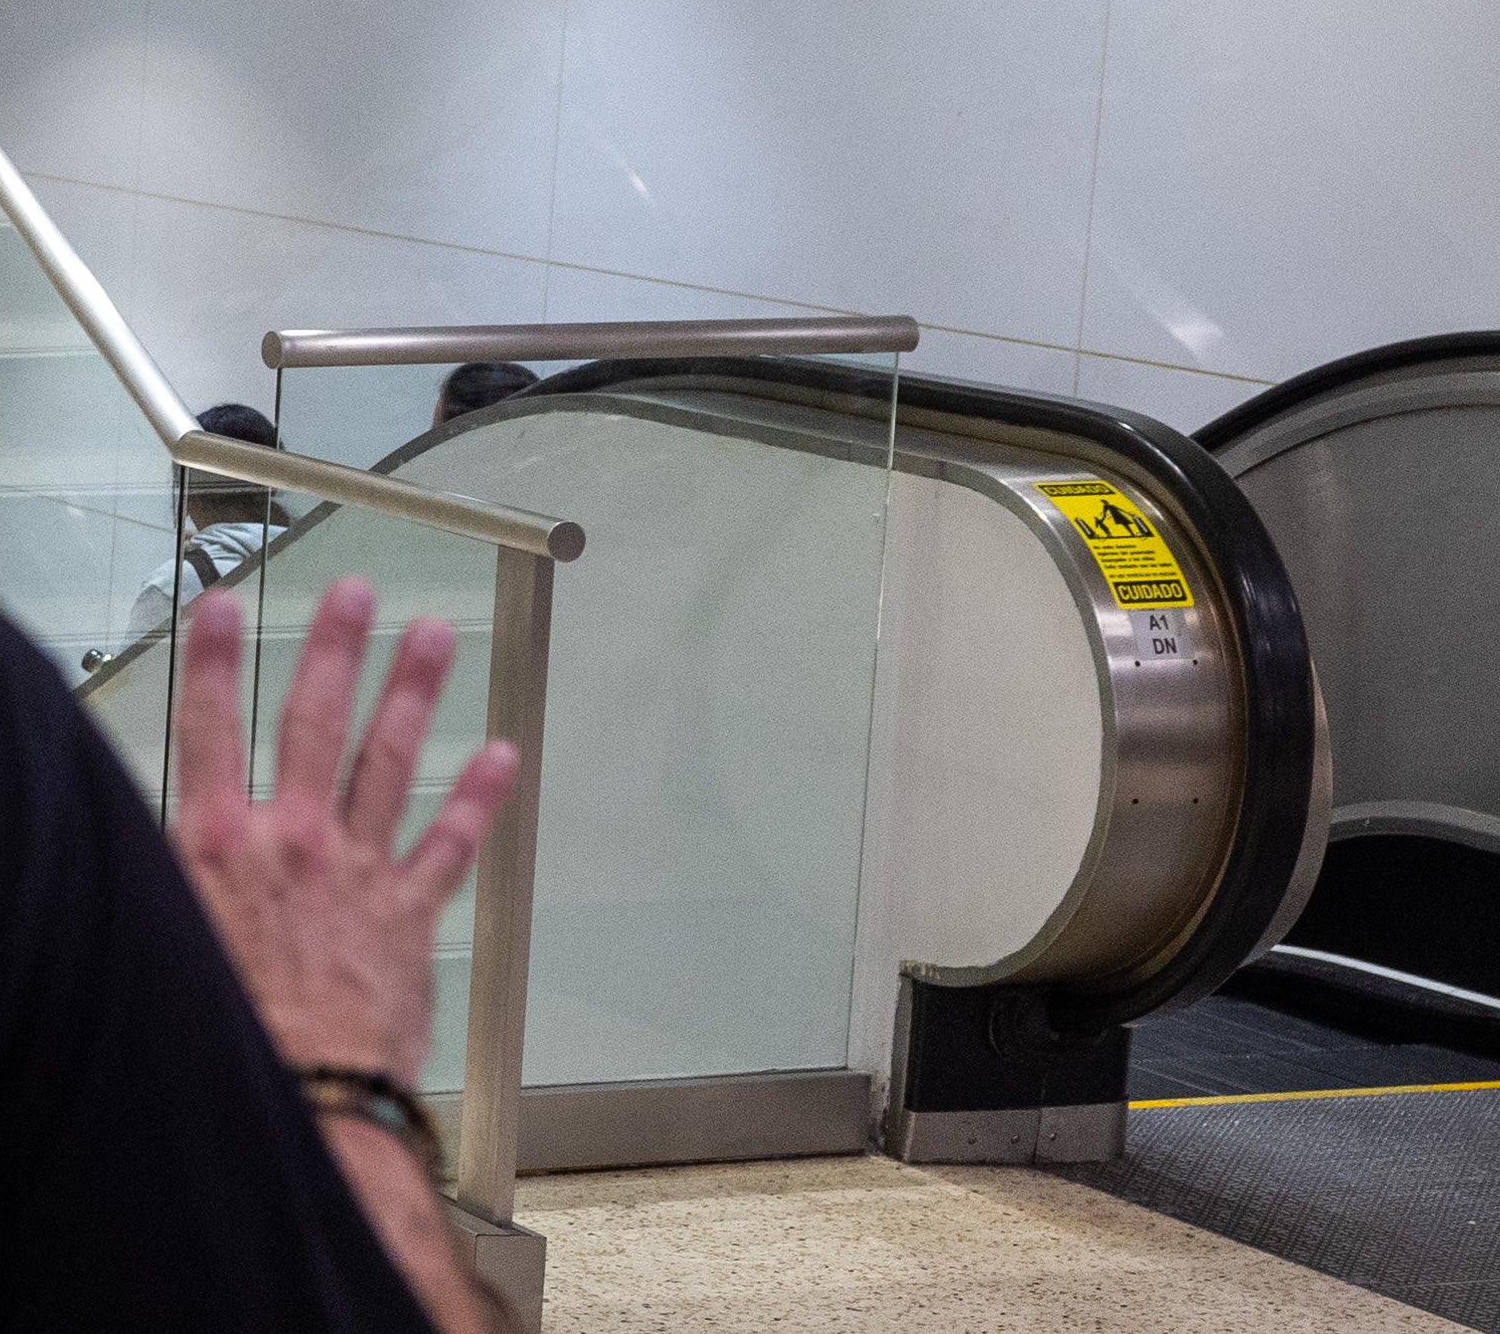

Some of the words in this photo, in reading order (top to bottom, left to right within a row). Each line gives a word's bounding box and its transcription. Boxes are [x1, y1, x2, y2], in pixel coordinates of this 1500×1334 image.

[1117, 583, 1183, 601] CUIDADO
[1149, 614, 1169, 631] A1
[1152, 637, 1178, 655] DN
